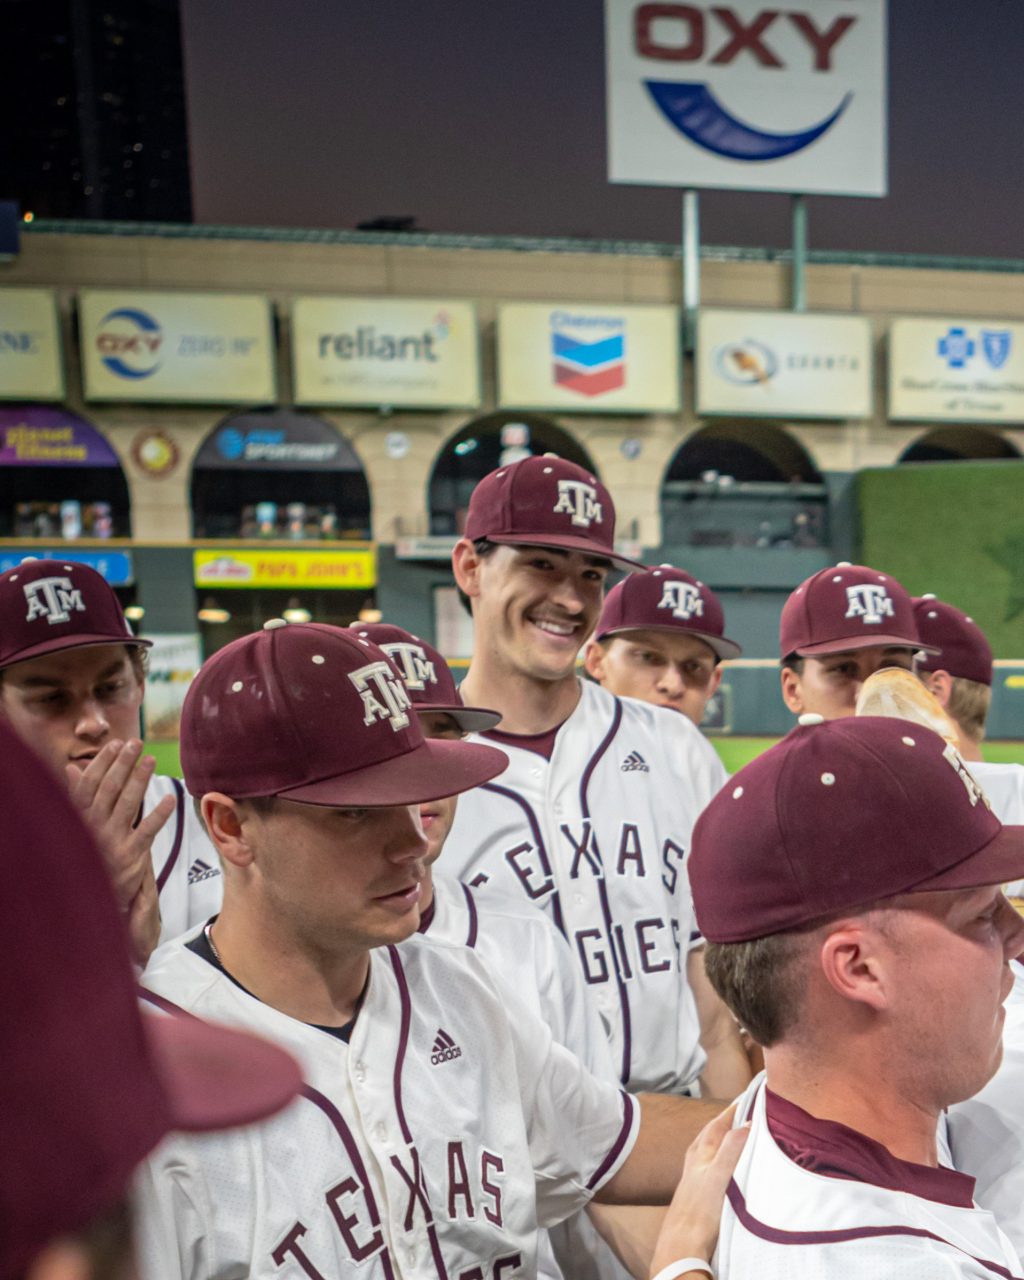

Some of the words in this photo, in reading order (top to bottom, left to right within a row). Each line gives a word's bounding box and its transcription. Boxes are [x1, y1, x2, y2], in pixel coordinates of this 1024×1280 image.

[634, 2, 857, 72] OXY
[96, 333, 162, 354] OXY
[319, 325, 438, 363] reliant
[257, 561, 298, 578] PAPA
[469, 822, 685, 901] EXAS
[430, 1045, 463, 1066] adidas
